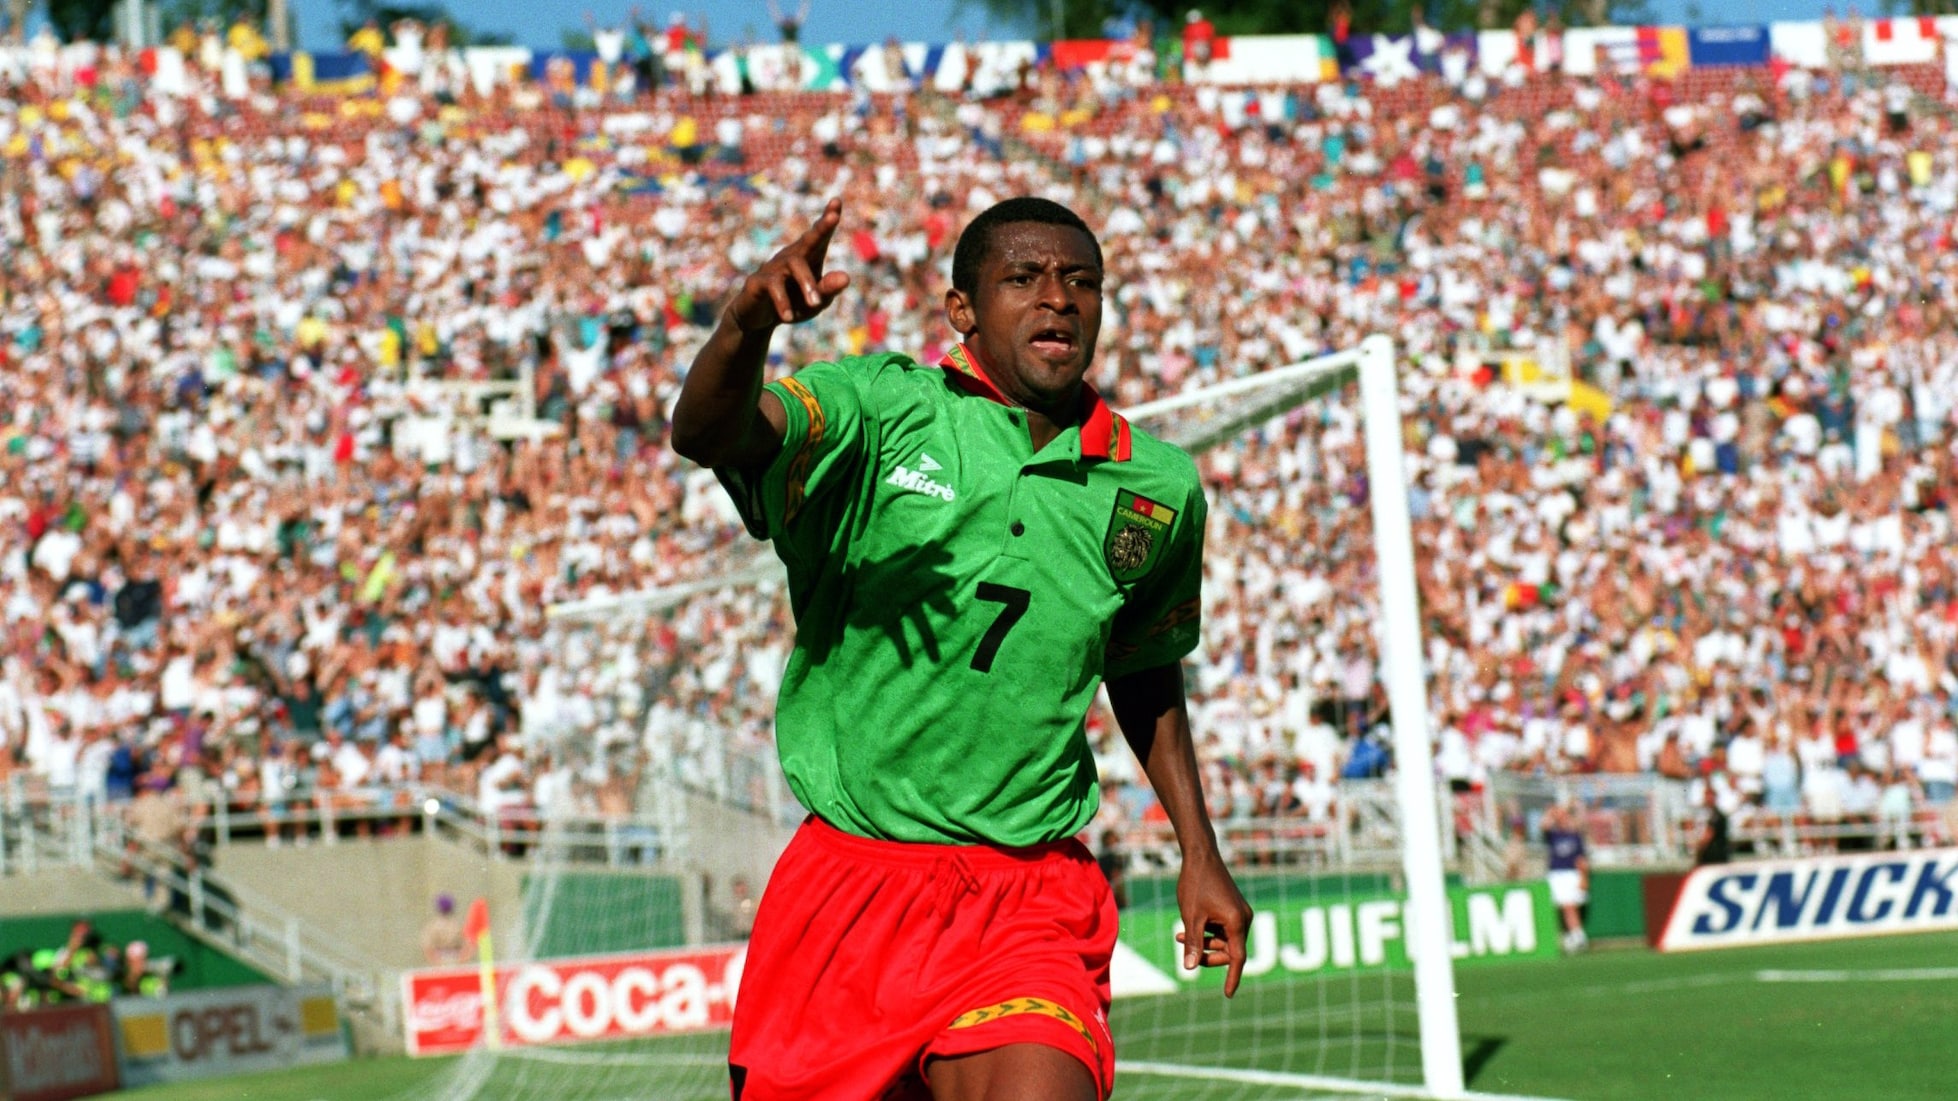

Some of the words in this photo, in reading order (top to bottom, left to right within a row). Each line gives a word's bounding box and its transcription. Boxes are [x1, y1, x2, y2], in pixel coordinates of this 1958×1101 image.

[1117, 507, 1162, 531] CAMEROUN
[970, 581, 1031, 674] 7
[1692, 861, 1958, 935] SNICK
[173, 1005, 272, 1061] OPEL
